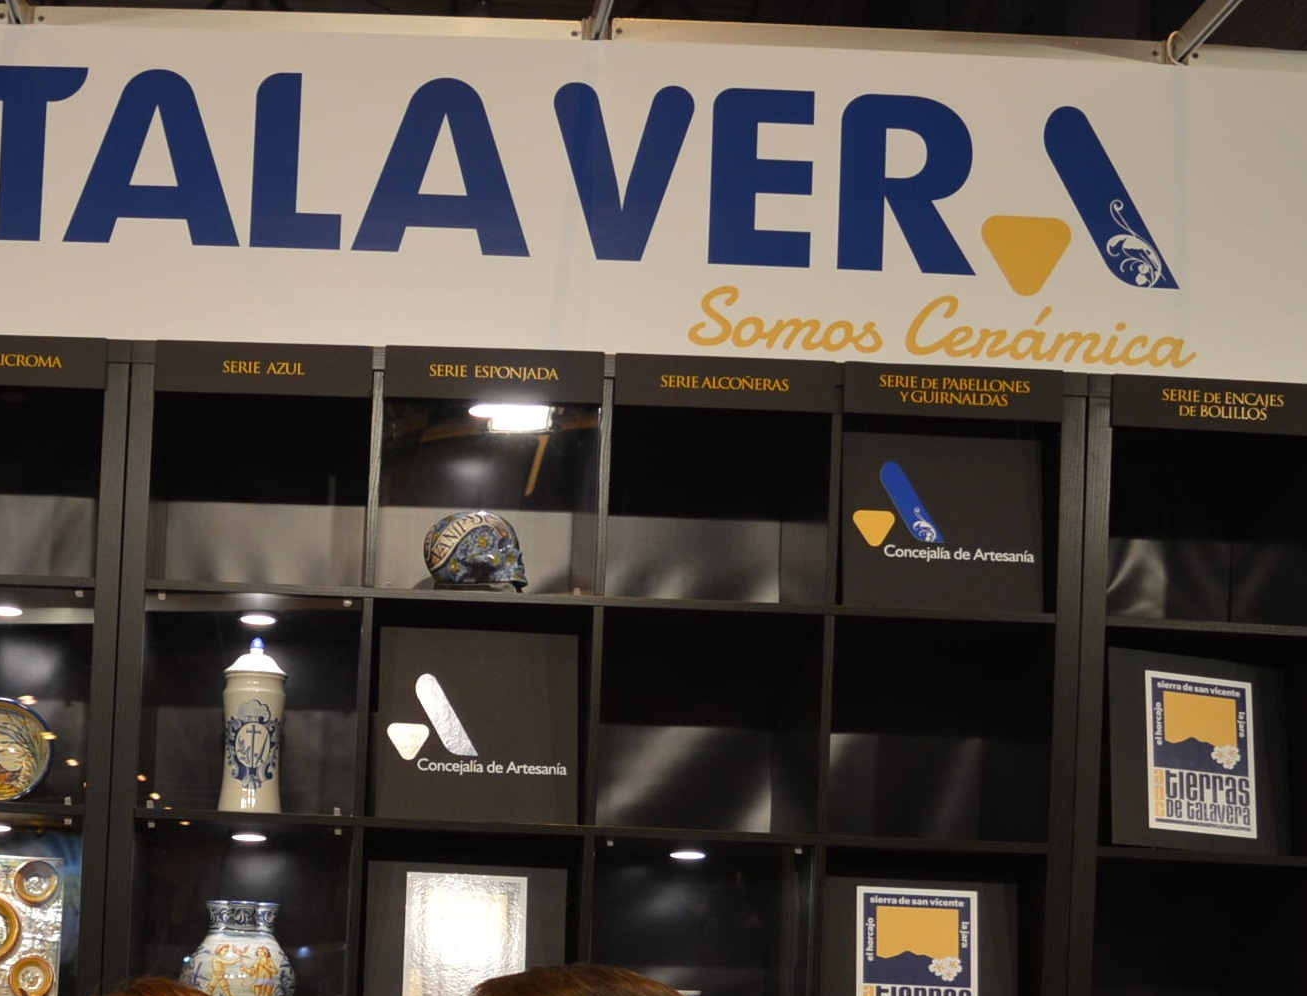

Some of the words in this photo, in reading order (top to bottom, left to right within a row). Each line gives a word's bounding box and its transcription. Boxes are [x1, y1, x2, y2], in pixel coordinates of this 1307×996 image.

[687, 285, 884, 354] Somos
[905, 295, 1198, 369] Cerámica
[222, 360, 260, 375] SERIE
[266, 361, 306, 376] AZUL
[429, 363, 467, 378] SERIE
[474, 365, 559, 382] ESPONJADA
[660, 374, 699, 390] SERIE
[701, 374, 790, 393] ALCOÑERAS
[879, 373, 917, 390] SERIE
[920, 376, 940, 391] DE
[942, 376, 1031, 395] PABELLONES
[900, 389, 910, 404] Y
[910, 389, 1009, 408] GUIRNALDAS
[1162, 388, 1200, 404] SERIE
[1203, 391, 1222, 406] DE
[1224, 391, 1285, 408] ENCAJES
[1178, 405, 1198, 418] DE
[1200, 405, 1268, 422] BOLILLOS
[883, 544, 951, 563] Concejalía
[953, 547, 971, 561] de
[973, 547, 1035, 564] Artesanía
[417, 757, 484, 775] Concejalía
[486, 760, 504, 774] de
[506, 761, 567, 776] Artesanía
[898, 896, 910, 905] de
